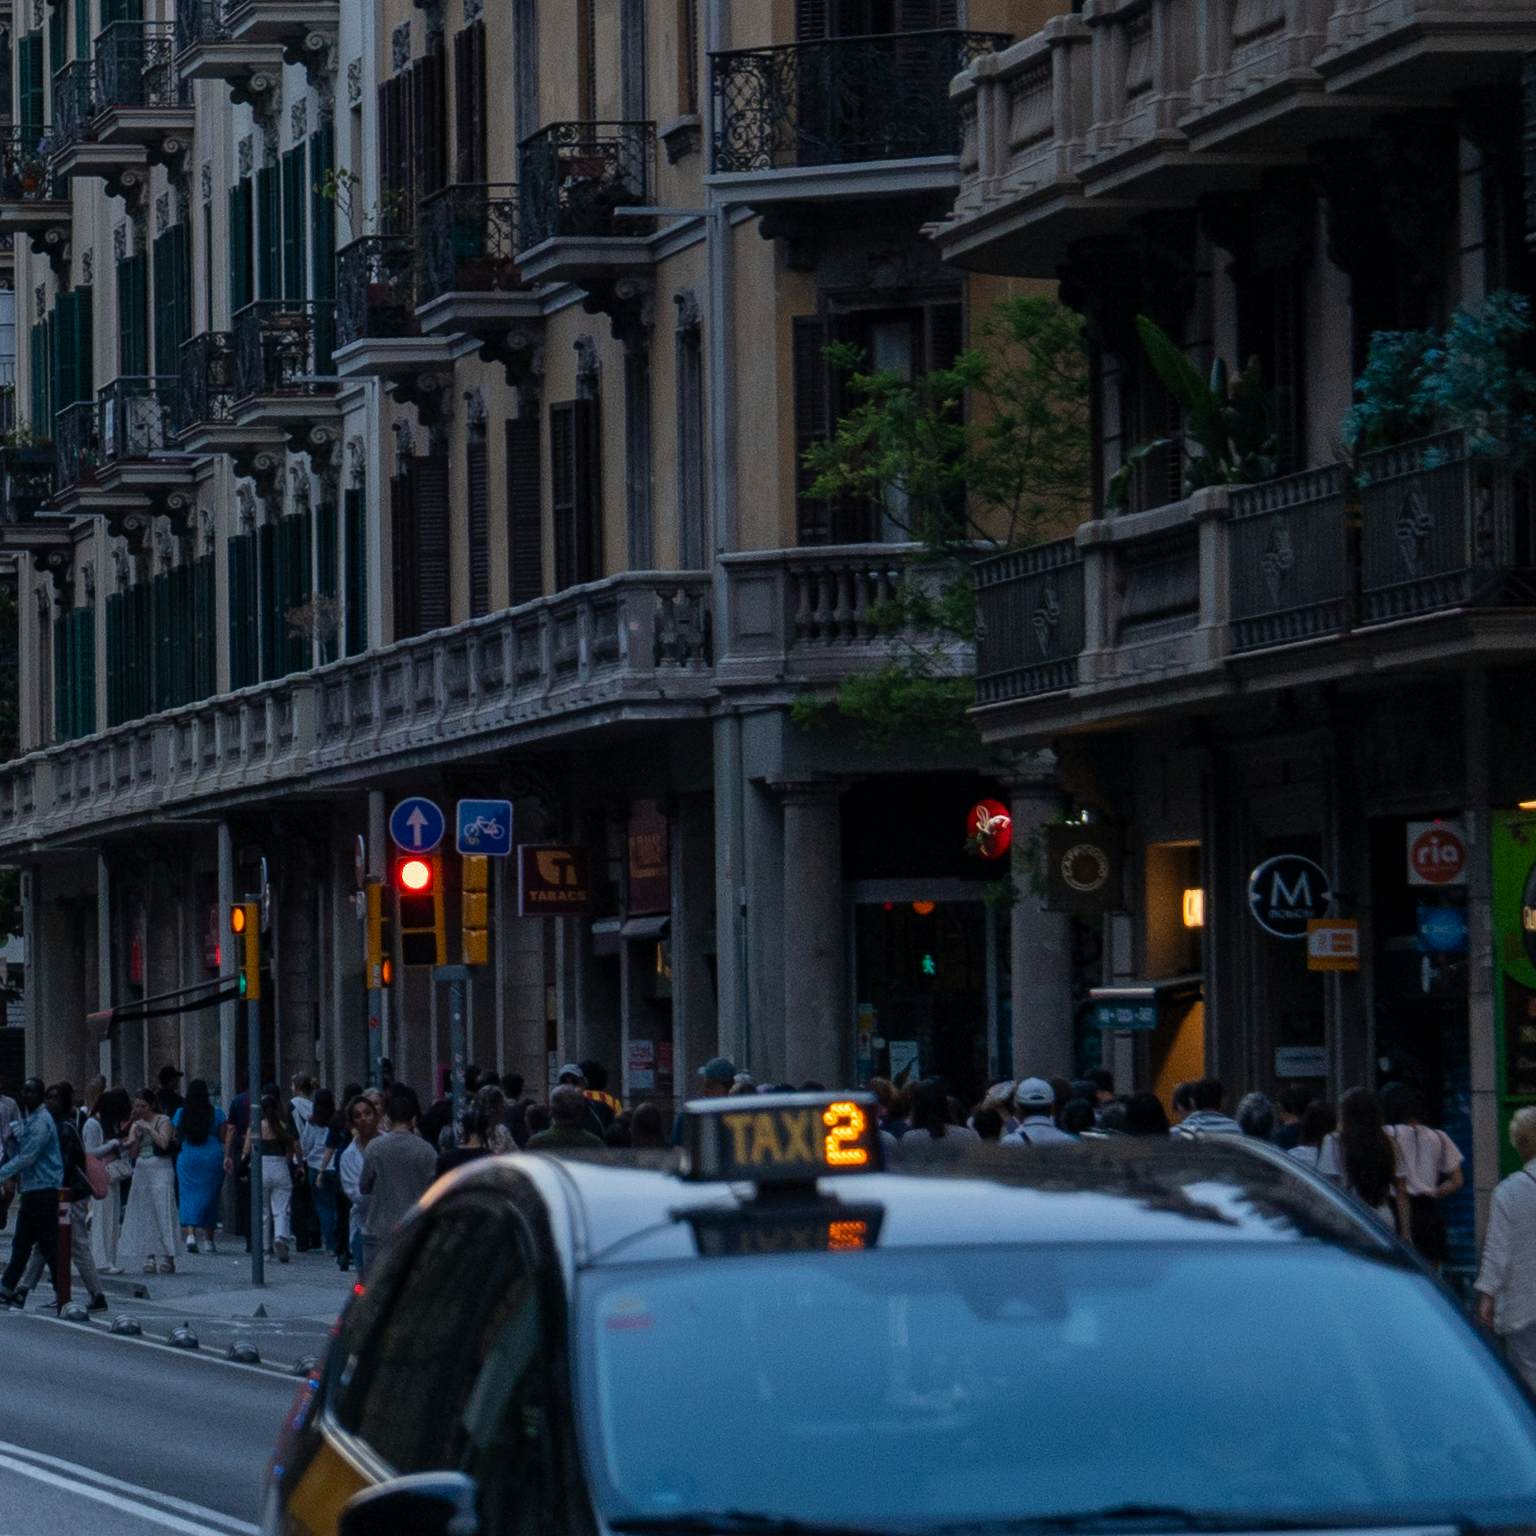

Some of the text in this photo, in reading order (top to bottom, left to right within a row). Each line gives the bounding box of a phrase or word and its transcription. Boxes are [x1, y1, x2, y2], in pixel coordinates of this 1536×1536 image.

[1418, 839, 1458, 864] ria
[528, 889, 588, 902] TABACS
[720, 1101, 869, 1167] TAXI 2
